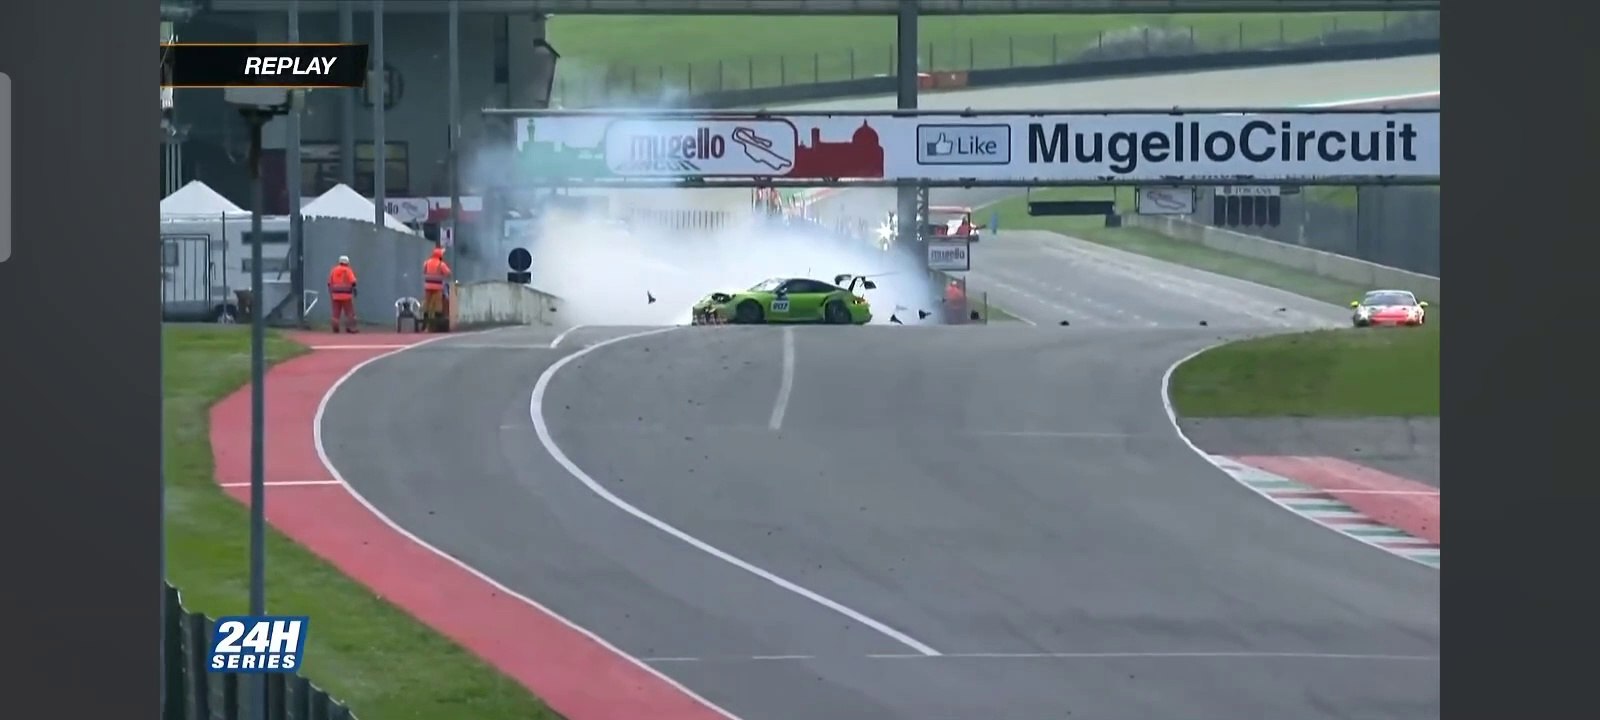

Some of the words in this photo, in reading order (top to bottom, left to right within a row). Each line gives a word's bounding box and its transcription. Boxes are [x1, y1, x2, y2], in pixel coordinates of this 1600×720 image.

[632, 127, 725, 160] mugello
[957, 137, 997, 155] Like
[1028, 120, 1417, 174] MugelloCircuit
